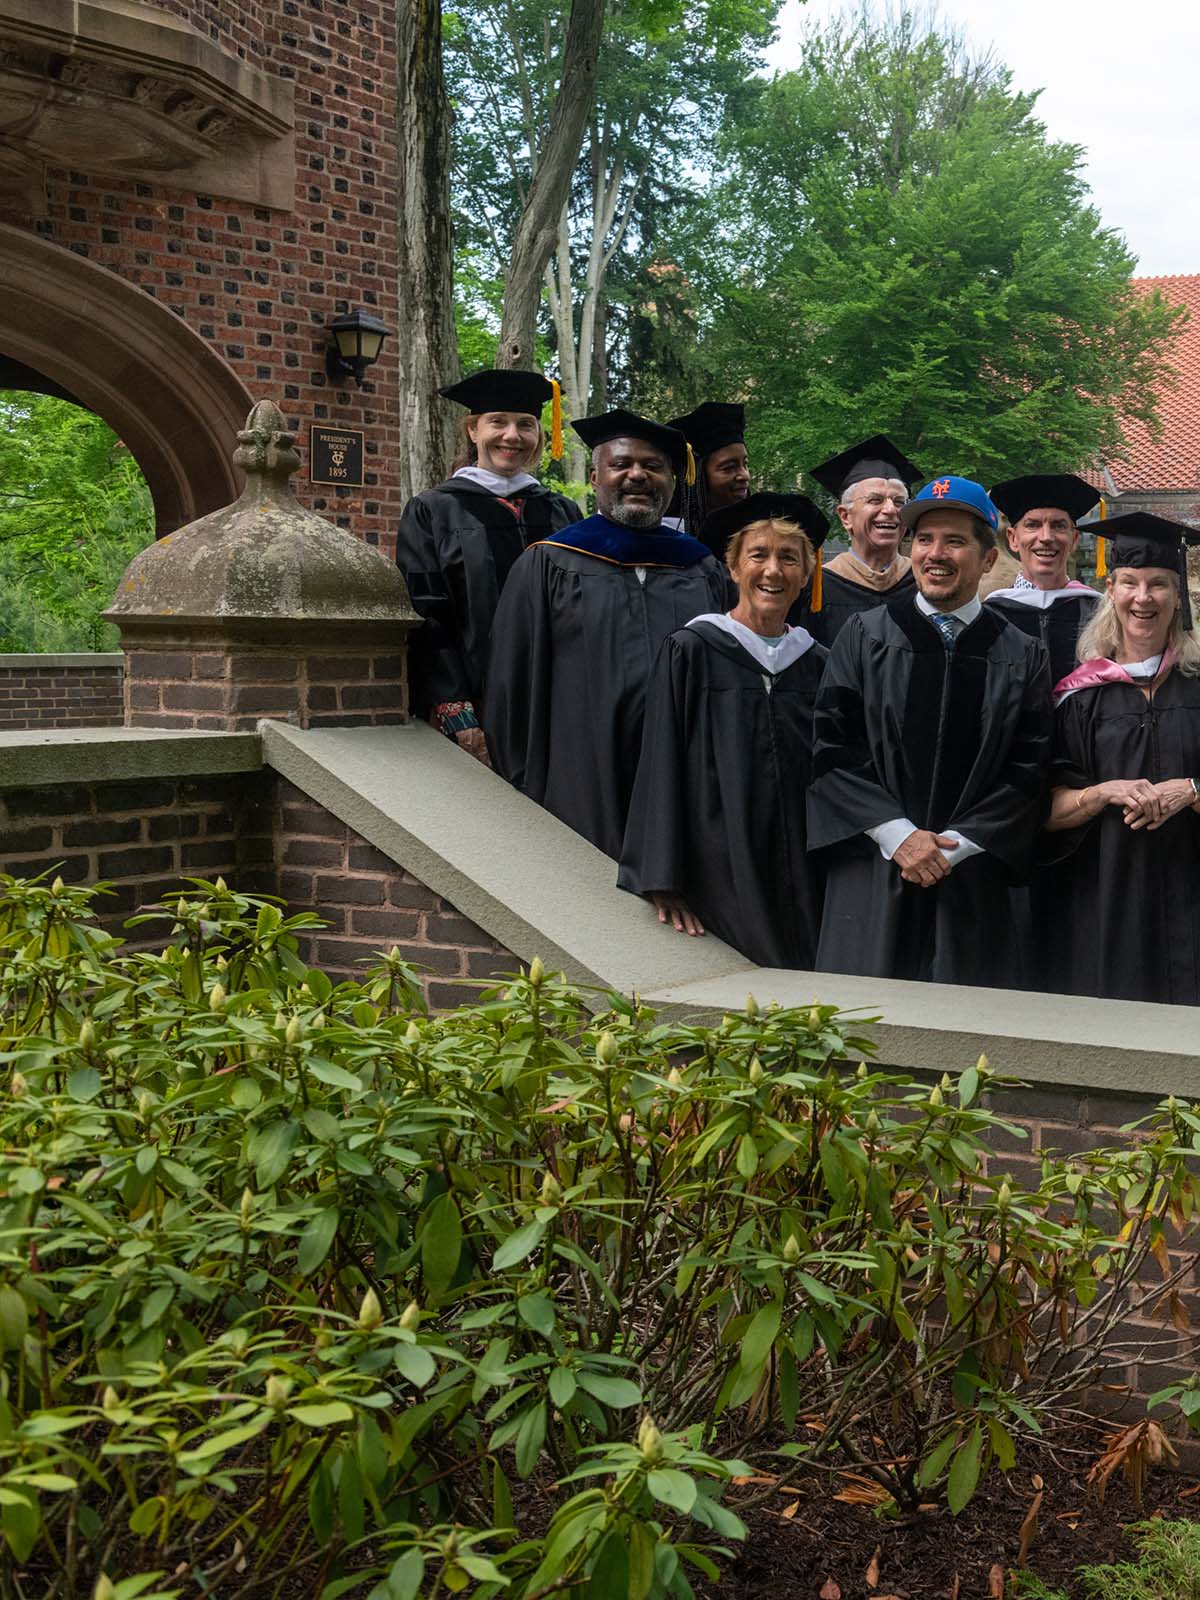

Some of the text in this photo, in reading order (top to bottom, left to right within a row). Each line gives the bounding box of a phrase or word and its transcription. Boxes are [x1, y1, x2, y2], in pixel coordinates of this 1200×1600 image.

[320, 435, 356, 445] PRESIDENT'S
[328, 443, 348, 451] HOUSE
[329, 467, 347, 478] 1895
